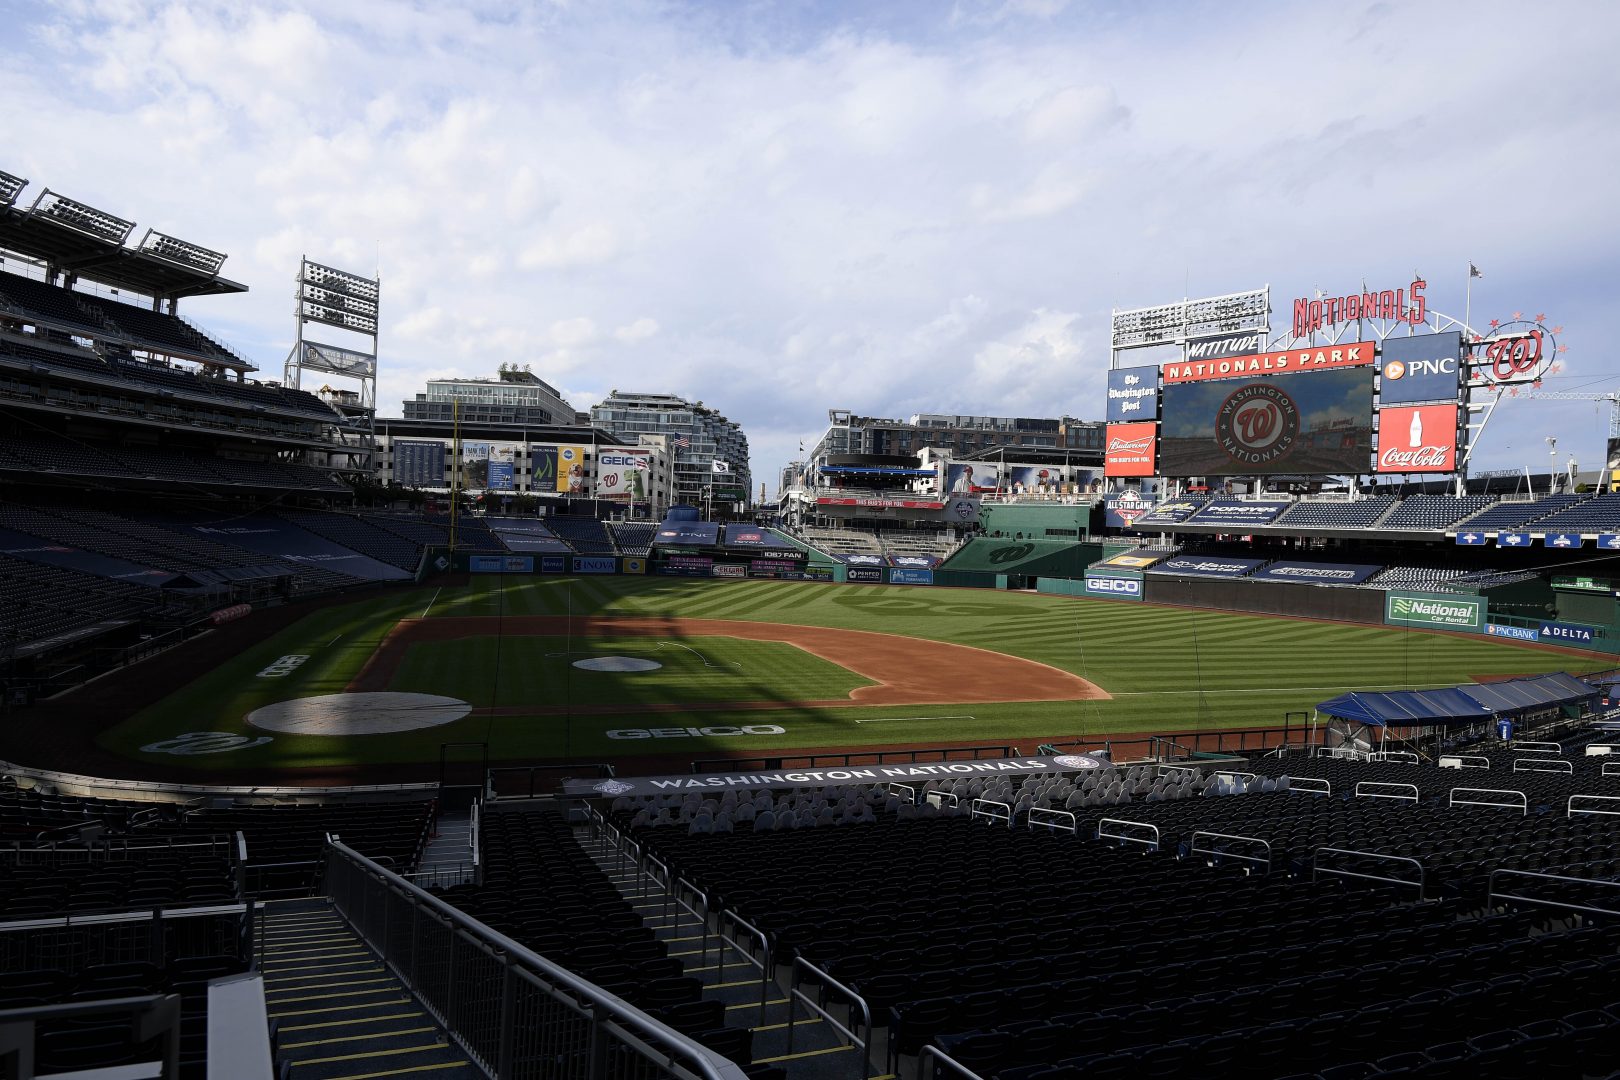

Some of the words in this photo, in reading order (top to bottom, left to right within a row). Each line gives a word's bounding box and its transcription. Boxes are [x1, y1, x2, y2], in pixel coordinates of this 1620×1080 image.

[1293, 281, 1427, 338] NATIONALS
[1188, 336, 1258, 358] NATITUDE
[1169, 355, 1288, 379] NATIONALS
[1300, 347, 1361, 365] PARK
[1408, 358, 1455, 377] PNC
[1124, 375, 1140, 385] The
[1108, 387, 1155, 399] Washington
[1223, 387, 1295, 414] WASHINGTON
[1122, 401, 1141, 413] Post
[1110, 440, 1149, 450] Budweiser
[1223, 436, 1292, 462] NATIONALS
[1381, 445, 1451, 468] Coca-Cola
[1107, 501, 1118, 510] ALL
[1119, 501, 1134, 510] STAR
[1135, 501, 1153, 510] GAME
[583, 560, 614, 569] INOVA
[1088, 578, 1139, 593] GEICO
[1445, 616, 1469, 624] Rental
[1554, 627, 1590, 640] DELTA
[606, 724, 786, 740] GEICO
[651, 769, 876, 789] WASHINGTON
[881, 760, 1048, 778] NATIONALS
